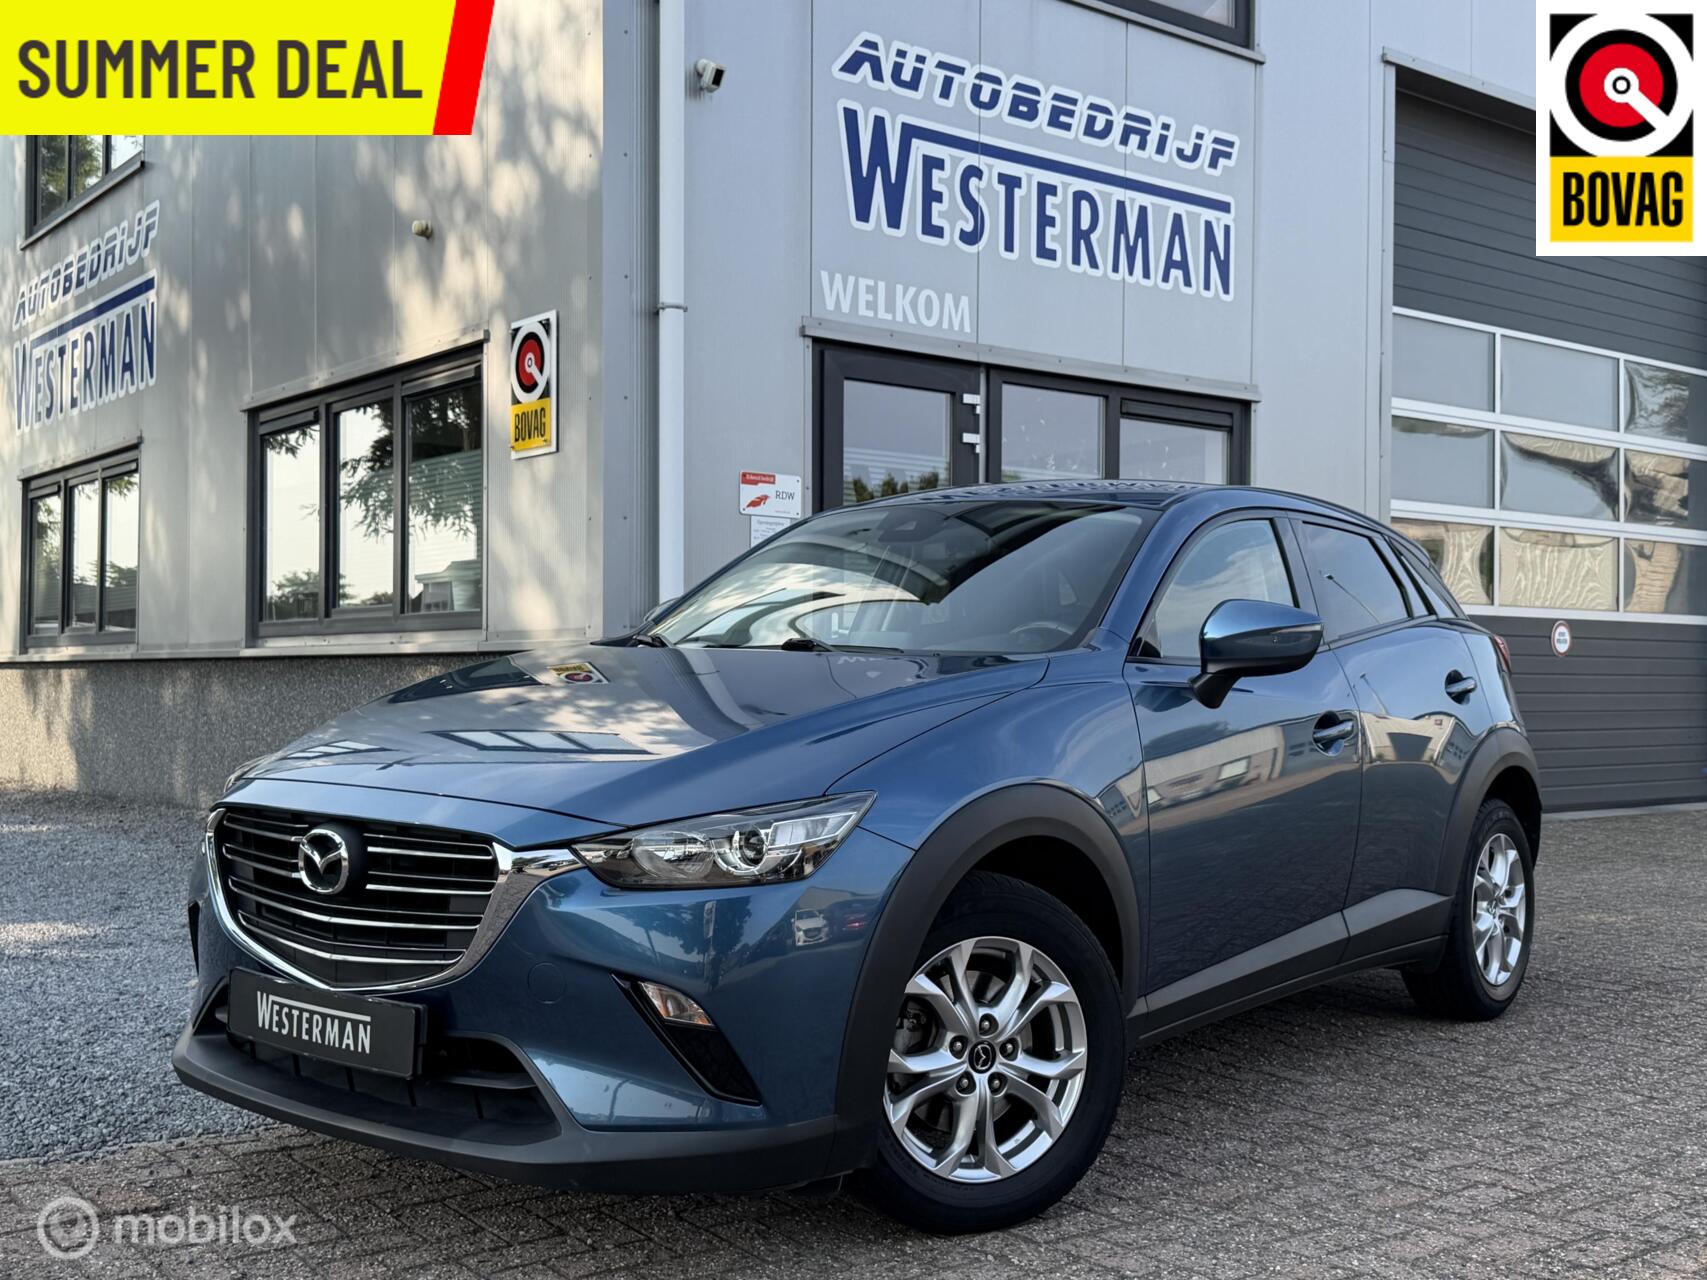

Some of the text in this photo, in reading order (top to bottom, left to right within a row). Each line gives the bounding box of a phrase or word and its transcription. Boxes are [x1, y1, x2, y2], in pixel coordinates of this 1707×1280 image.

[836, 37, 1237, 171] AUTOBEDRIJF
[842, 105, 1232, 296] WESTERMAN
[14, 204, 159, 325] AUTOBEDRIJF
[819, 270, 971, 333] WELKOM
[14, 298, 156, 431] WESTERMAN
[514, 407, 546, 443] BOVAG
[775, 489, 795, 501] RDW
[256, 990, 371, 1054] WESTERMAN
